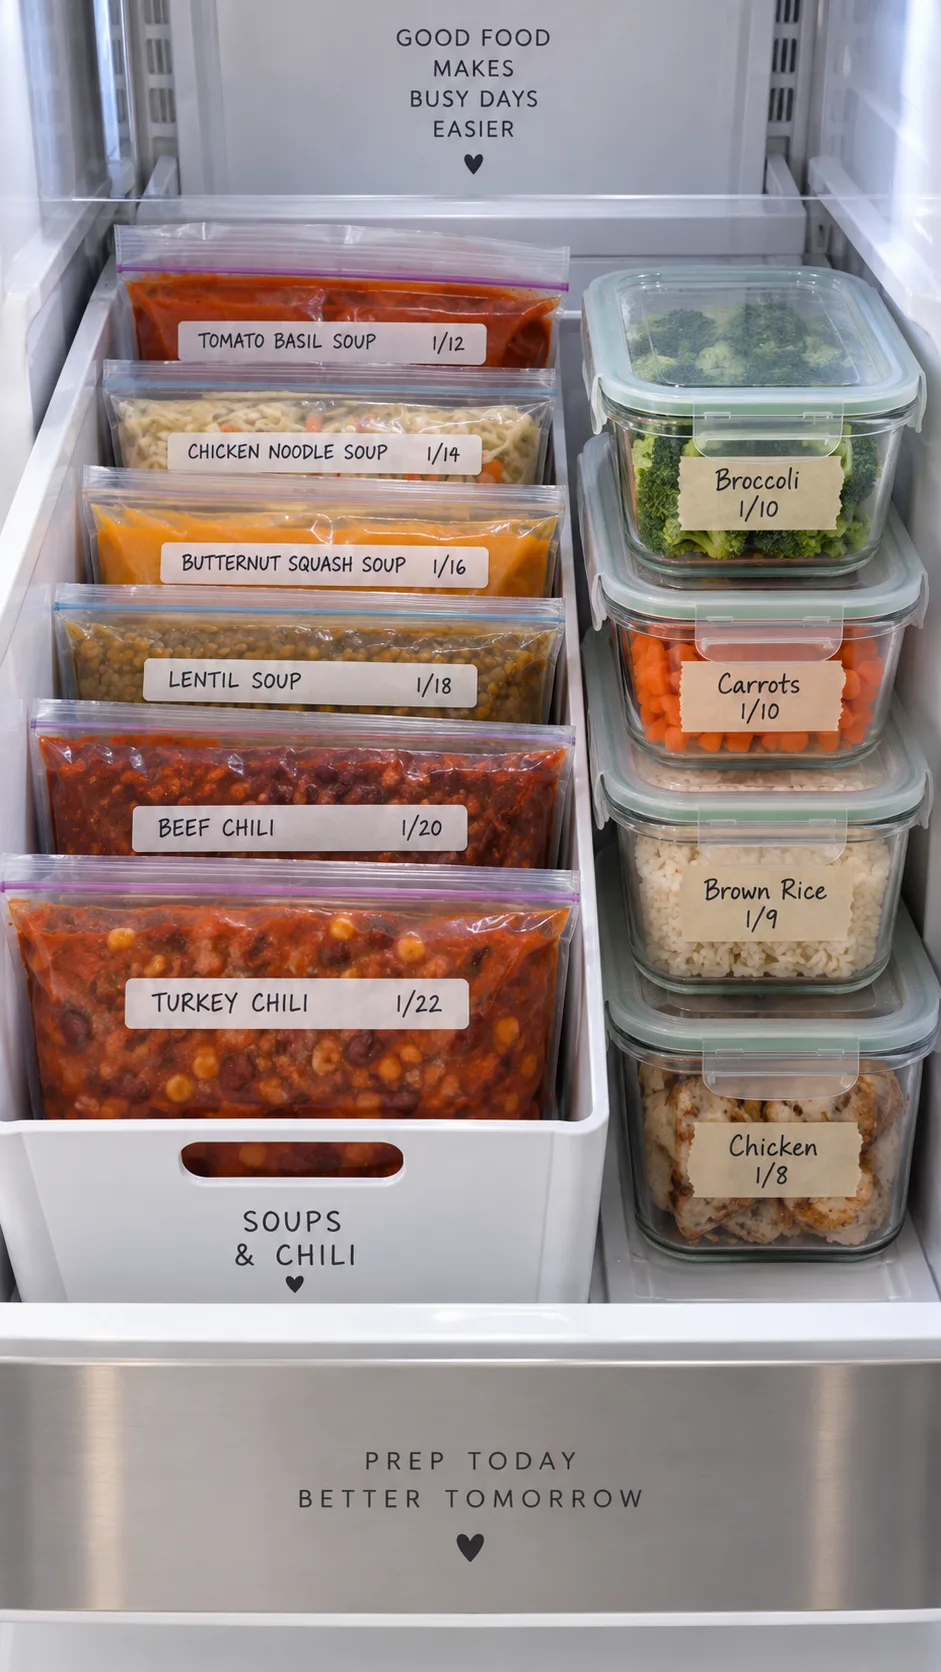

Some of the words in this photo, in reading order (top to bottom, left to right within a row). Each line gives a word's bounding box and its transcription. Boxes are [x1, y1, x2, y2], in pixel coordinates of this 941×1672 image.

[396, 28, 470, 47] GOOD
[481, 28, 551, 47] FOOD
[433, 59, 514, 78] MAKES
[410, 89, 469, 108] BUSY
[480, 89, 538, 108] DAYS
[433, 119, 514, 138] EASIER
[197, 331, 265, 349] TOMATO
[273, 332, 323, 350] BASIL
[332, 332, 377, 351] SOUP
[432, 331, 466, 355] 1/12
[187, 442, 260, 460] CHICKEN
[268, 442, 335, 461] NOODLE
[344, 443, 389, 461] SOUP
[427, 441, 461, 466] 1/14
[714, 466, 800, 492] Broccoli
[739, 495, 779, 522] 1/10
[181, 553, 282, 572] BUTTERNUT
[288, 554, 353, 573] SQUASH
[361, 555, 407, 574] SOUP
[433, 553, 467, 579] 1/16
[168, 670, 240, 689] LENTIL
[251, 671, 302, 691] SOUP
[416, 672, 452, 698] 1/18
[717, 671, 801, 695] Carrots
[741, 699, 780, 725] 1/10
[157, 817, 211, 839] BEEF
[222, 818, 274, 837] CHILI
[402, 813, 443, 842] 1/20
[703, 877, 771, 902] Brown
[780, 877, 828, 901] Rice
[746, 905, 778, 933] 1/9
[150, 991, 239, 1015] TURKEY
[251, 992, 308, 1013] CHILI
[396, 989, 443, 1019] 1/22
[729, 1133, 818, 1158] Chicken
[755, 1161, 788, 1189] 1/8
[243, 1209, 342, 1233] SOUPS
[234, 1242, 255, 1267] &
[275, 1243, 355, 1267] CHILI
[365, 1451, 444, 1471] PREP
[467, 1451, 576, 1471] TODAY
[298, 1489, 421, 1509] BETTER
[444, 1489, 642, 1509] TOMORROW
